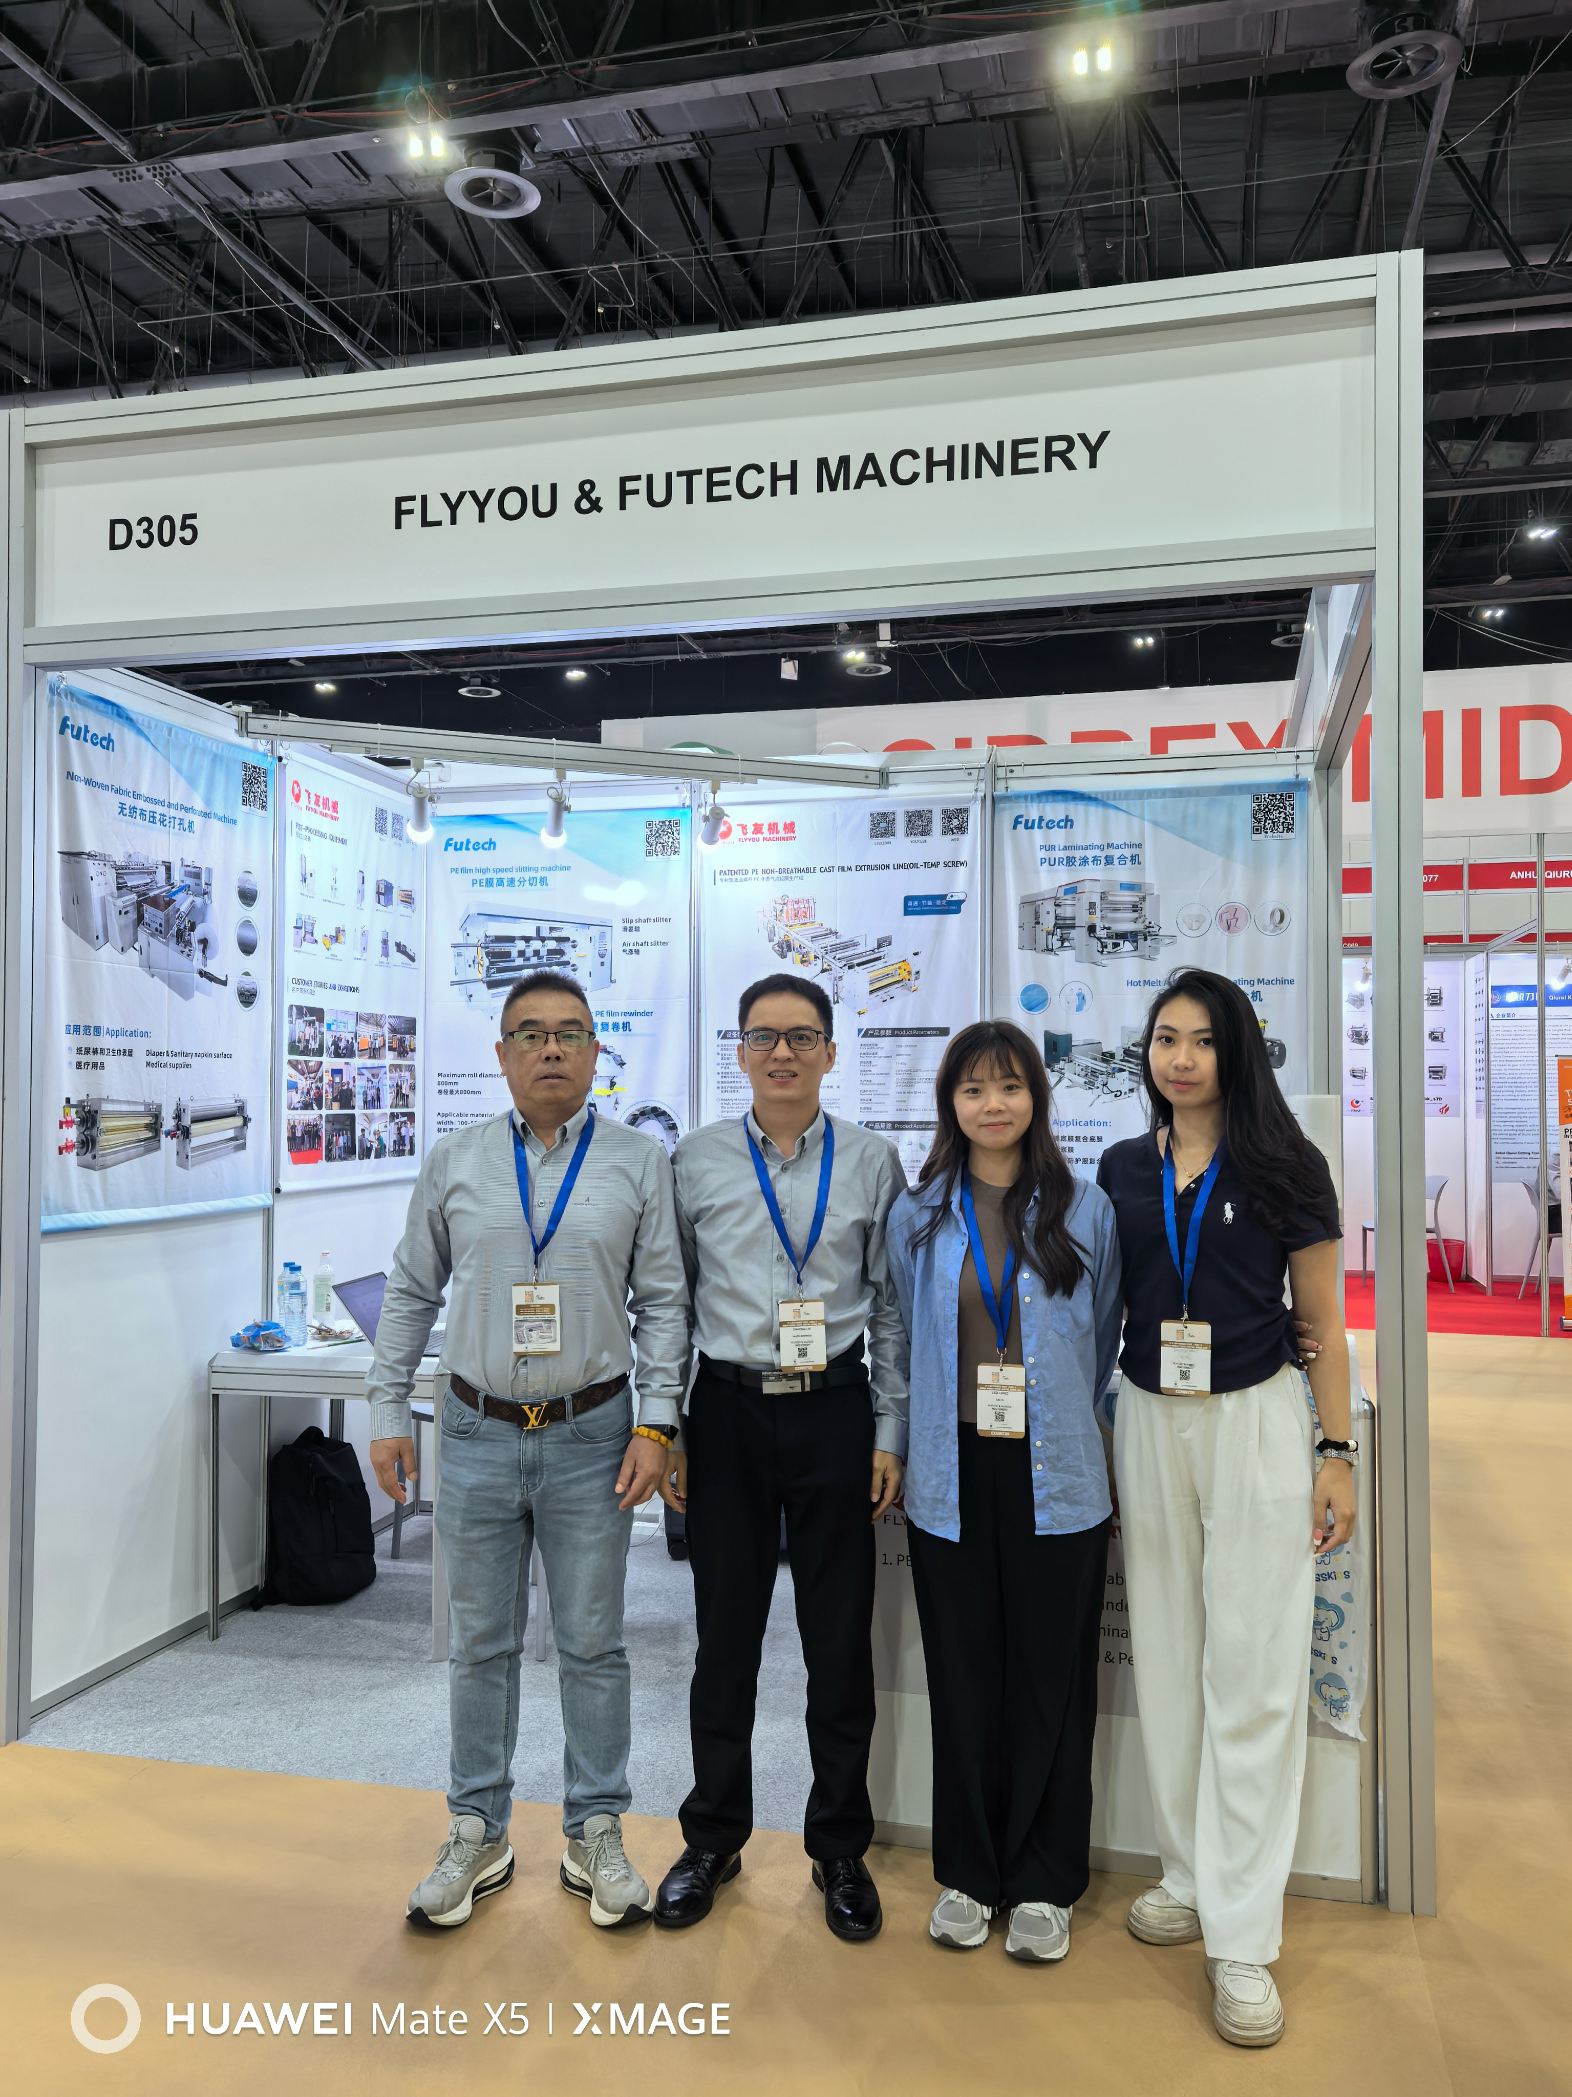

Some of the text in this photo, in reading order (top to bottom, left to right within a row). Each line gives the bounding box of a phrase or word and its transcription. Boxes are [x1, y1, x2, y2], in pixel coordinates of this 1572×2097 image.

[395, 431, 1110, 529] FLYYOU & FUTECH MACHINERY
[109, 513, 198, 550] D305
[58, 715, 115, 753] Futech
[66, 770, 238, 826] Non-Woven Fabric Embossed and Perforated Machine
[118, 801, 196, 834] 无纺布压花打孔机
[1012, 814, 1075, 830] Futech
[736, 820, 796, 836] 飞友机械
[443, 837, 497, 852] Futech
[1039, 841, 1143, 853] PUR Laminating Machine
[1040, 853, 1142, 868] PUR胶涂布复合机
[450, 864, 572, 876] PE film high speed slitting machine
[719, 868, 749, 877] PATENTED
[751, 868, 759, 876] PE
[761, 866, 817, 875] NON-BREATHABLE
[819, 865, 836, 873] CAST
[837, 864, 853, 872] FILM
[855, 863, 891, 872] EXTRUSION
[942, 860, 968, 868] SCREW)
[471, 876, 549, 889] PE膜高速分切机
[1126, 979, 1142, 987] Hot
[1143, 978, 1162, 987] Melt
[1233, 978, 1255, 987] ating
[1256, 976, 1295, 986] Machine
[65, 1024, 152, 1039] 应用范围 Application:
[145, 1049, 165, 1058] Diaper
[170, 1050, 194, 1059] Sanitary
[145, 1060, 192, 1070] Medical supplies
[1052, 1118, 1112, 1129] Application:
[881, 1553, 892, 1566] 1.
[1104, 1651, 1115, 1664] &
